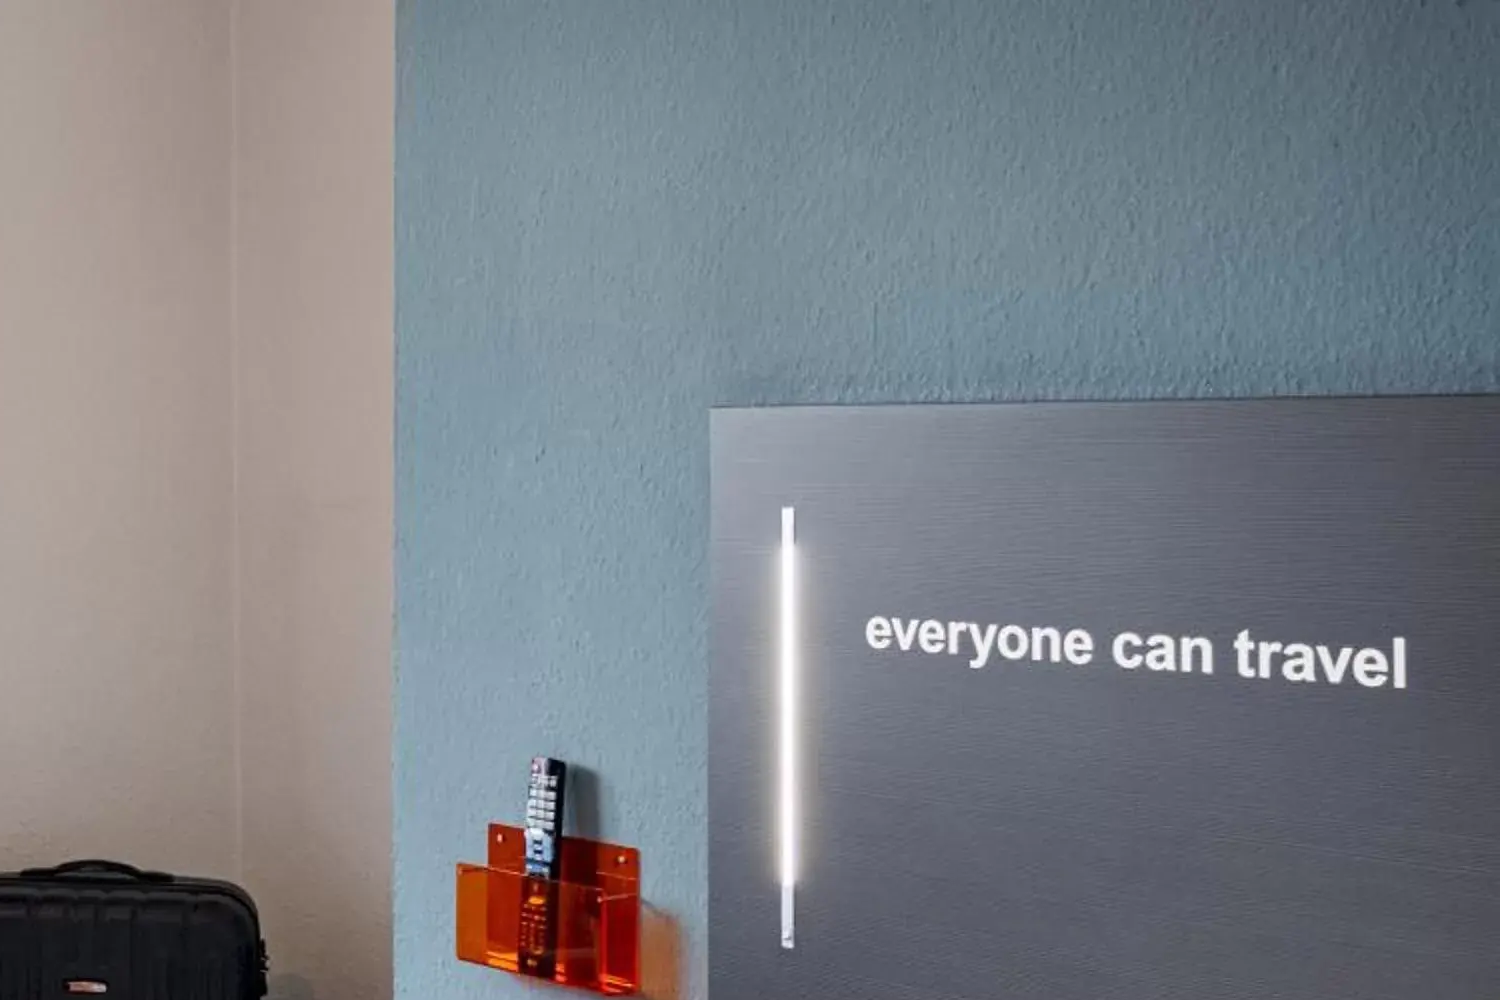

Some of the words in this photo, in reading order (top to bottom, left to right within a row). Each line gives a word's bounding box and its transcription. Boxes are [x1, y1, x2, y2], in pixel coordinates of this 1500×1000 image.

[865, 615, 1094, 669] everyone
[1112, 632, 1213, 674] can
[1233, 629, 1406, 689] travel
